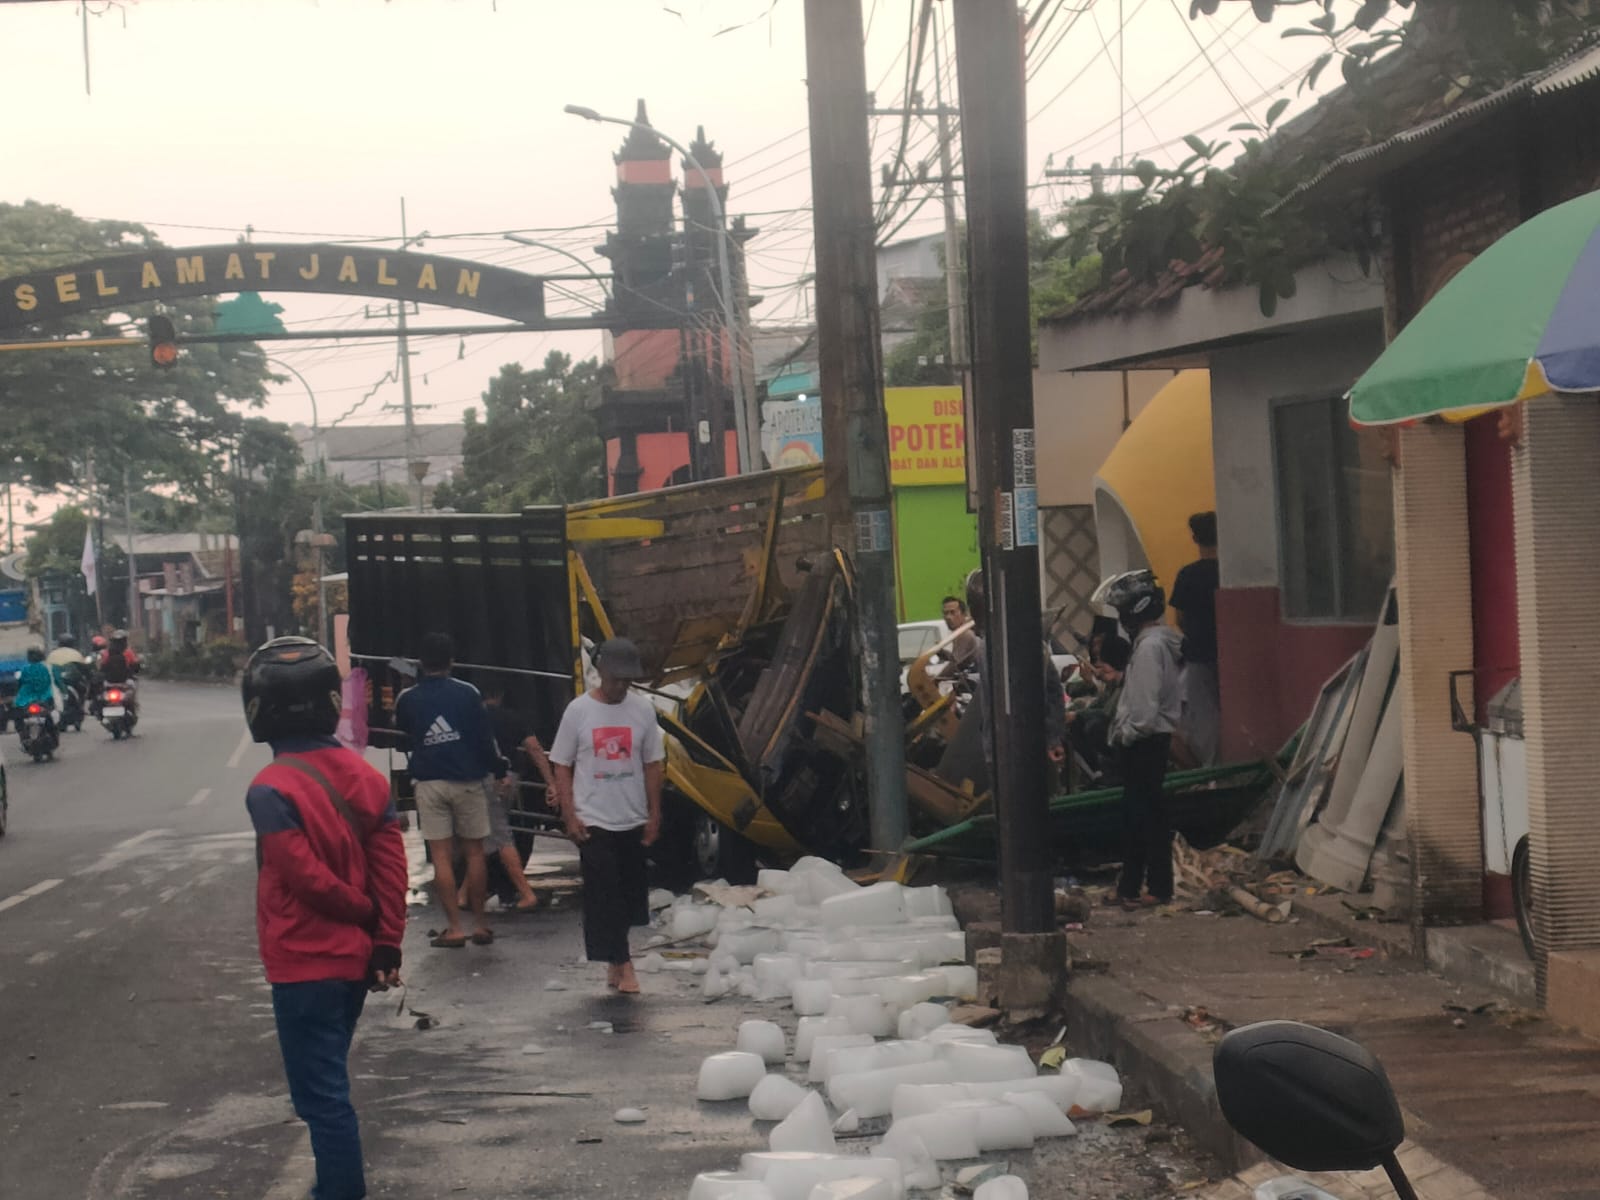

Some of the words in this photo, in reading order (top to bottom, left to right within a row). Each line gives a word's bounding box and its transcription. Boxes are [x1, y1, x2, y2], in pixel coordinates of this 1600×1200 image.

[15, 251, 275, 311] SELAMAT
[299, 253, 481, 298] JALAN
[890, 423, 965, 452] POTEK
[891, 457, 912, 470] BAT
[916, 456, 938, 469] DAN
[424, 731, 460, 746] adidas
